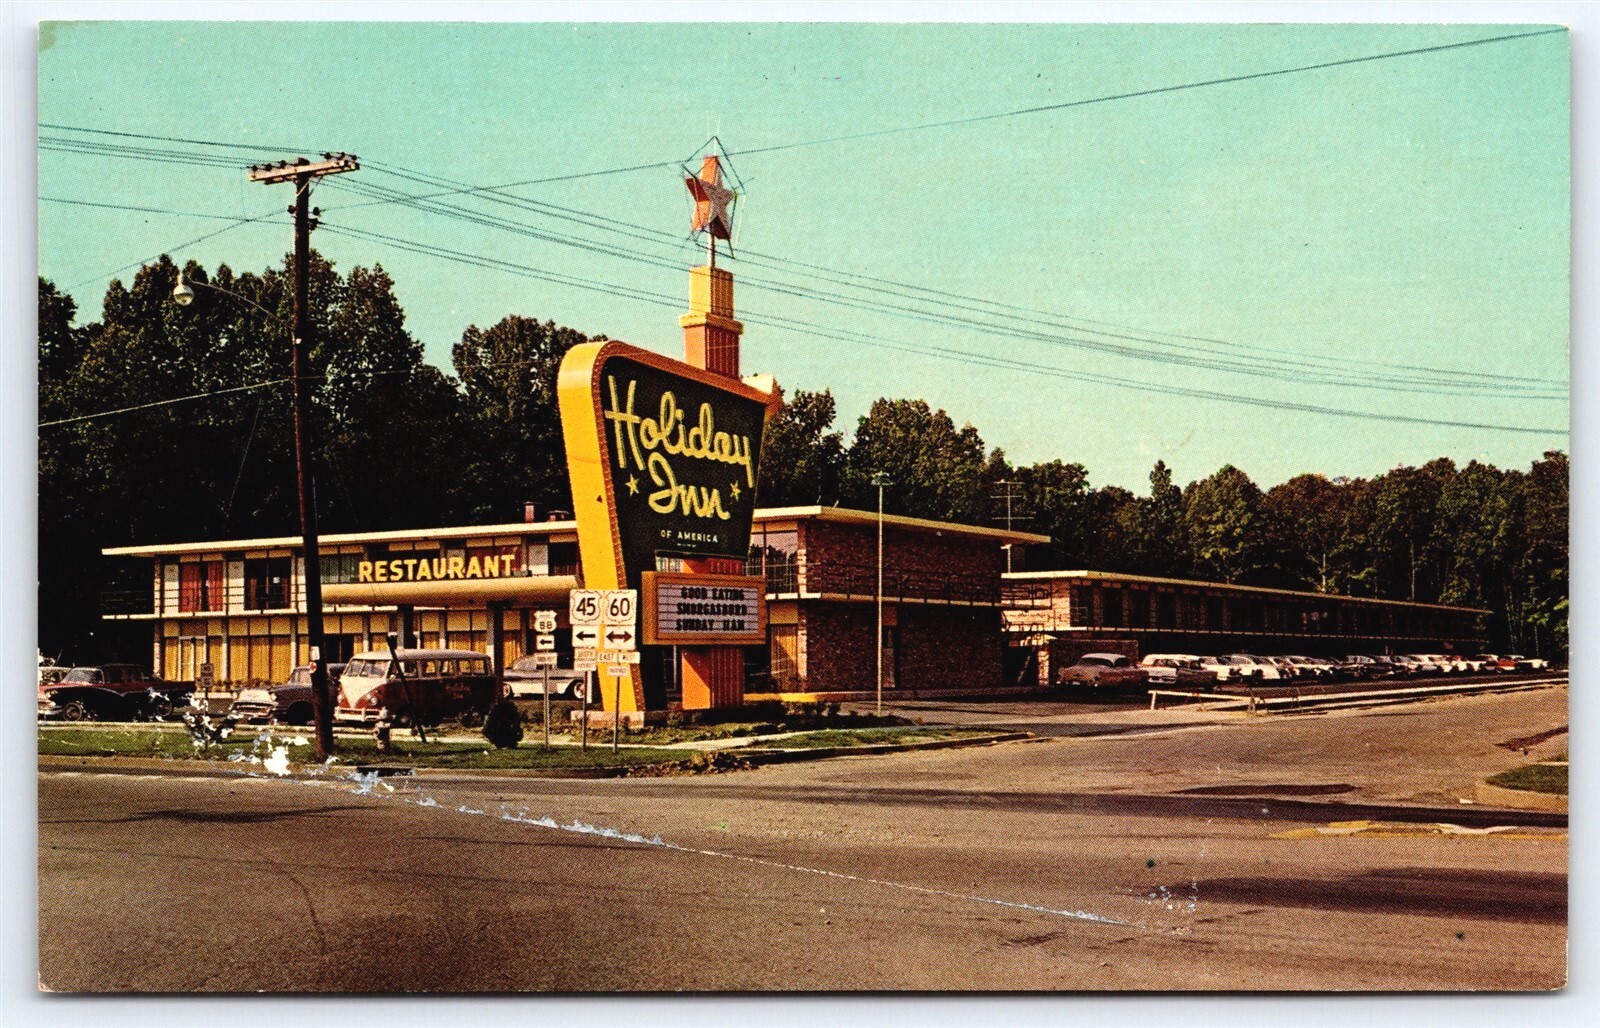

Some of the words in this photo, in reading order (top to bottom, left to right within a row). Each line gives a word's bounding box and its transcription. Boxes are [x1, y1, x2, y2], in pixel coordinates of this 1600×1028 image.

[604, 375, 754, 488] Holiday
[648, 451, 731, 520] Inn
[660, 529, 672, 539] OF
[677, 531, 718, 543] AMERICA
[358, 554, 516, 583] RESTAURANT
[681, 587, 707, 599] GOOD
[712, 588, 744, 600] EATING
[576, 597, 595, 616] 45
[610, 597, 630, 616] 60
[675, 618, 714, 631] SUNDAY
[599, 653, 614, 661] EAST
